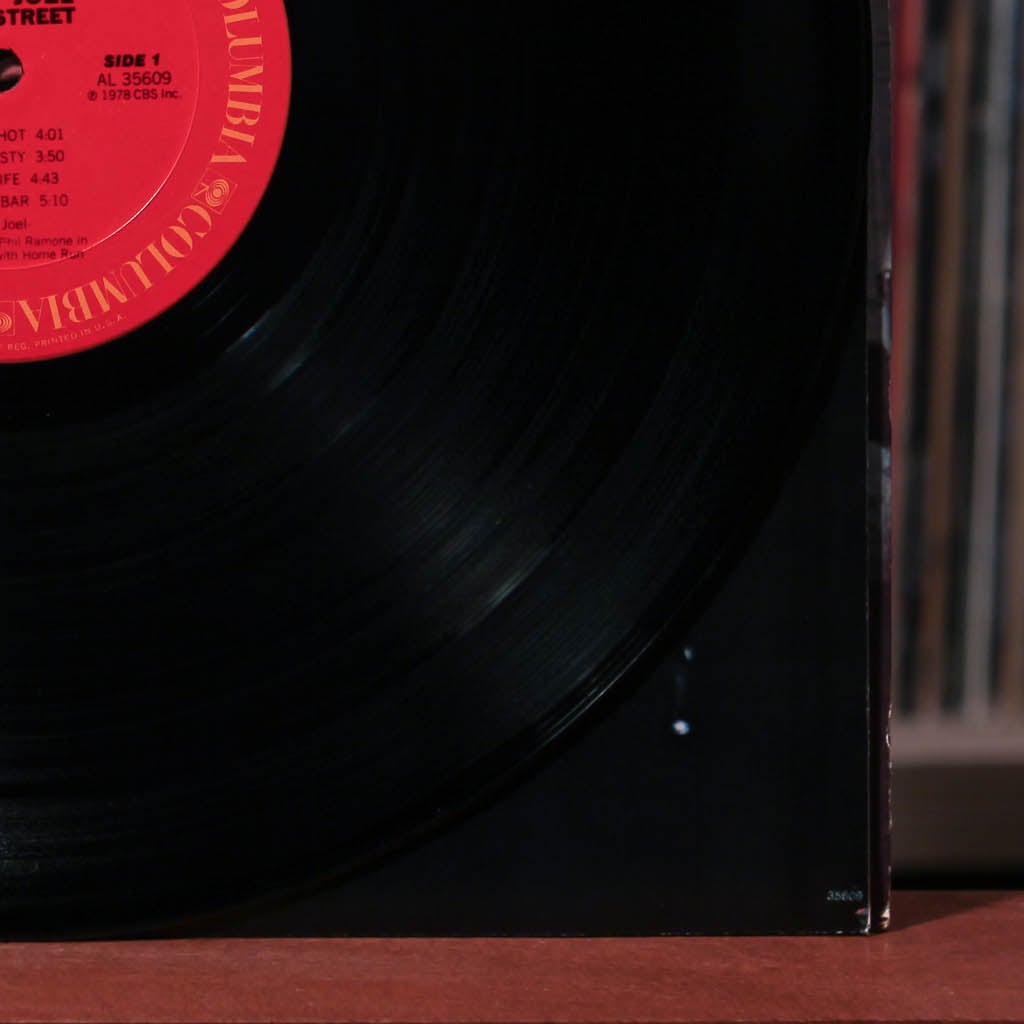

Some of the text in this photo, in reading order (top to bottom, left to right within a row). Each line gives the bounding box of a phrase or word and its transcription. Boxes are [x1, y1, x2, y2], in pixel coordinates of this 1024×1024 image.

[104, 53, 160, 68] SIDE 1
[97, 71, 172, 87] AL 35609
[102, 89, 131, 101] 1978
[133, 88, 158, 100] CBS
[26, 235, 73, 247] Ramone
[77, 235, 88, 245] in
[22, 249, 57, 261] Home
[17, 204, 212, 333] COLUMBIA
